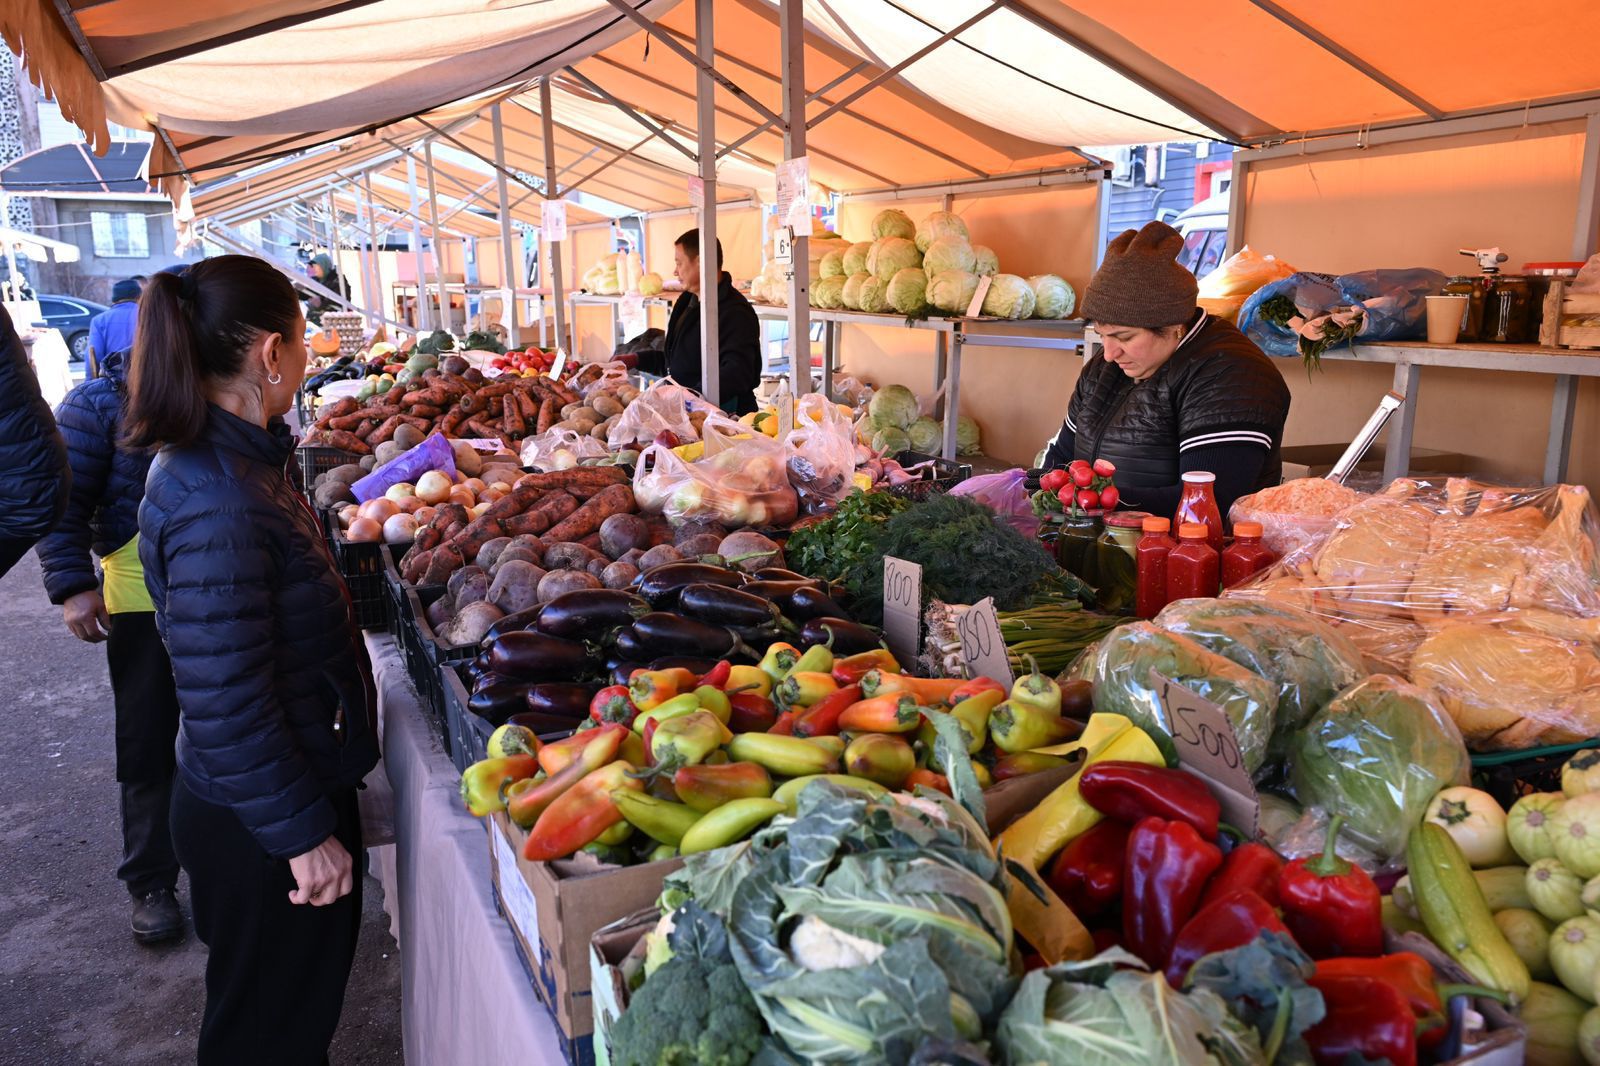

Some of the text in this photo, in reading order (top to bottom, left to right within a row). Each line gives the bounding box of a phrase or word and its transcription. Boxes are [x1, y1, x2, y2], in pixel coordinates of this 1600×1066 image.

[886, 561, 912, 606] 800
[958, 609, 991, 663] 850
[1162, 682, 1238, 769] 1500
